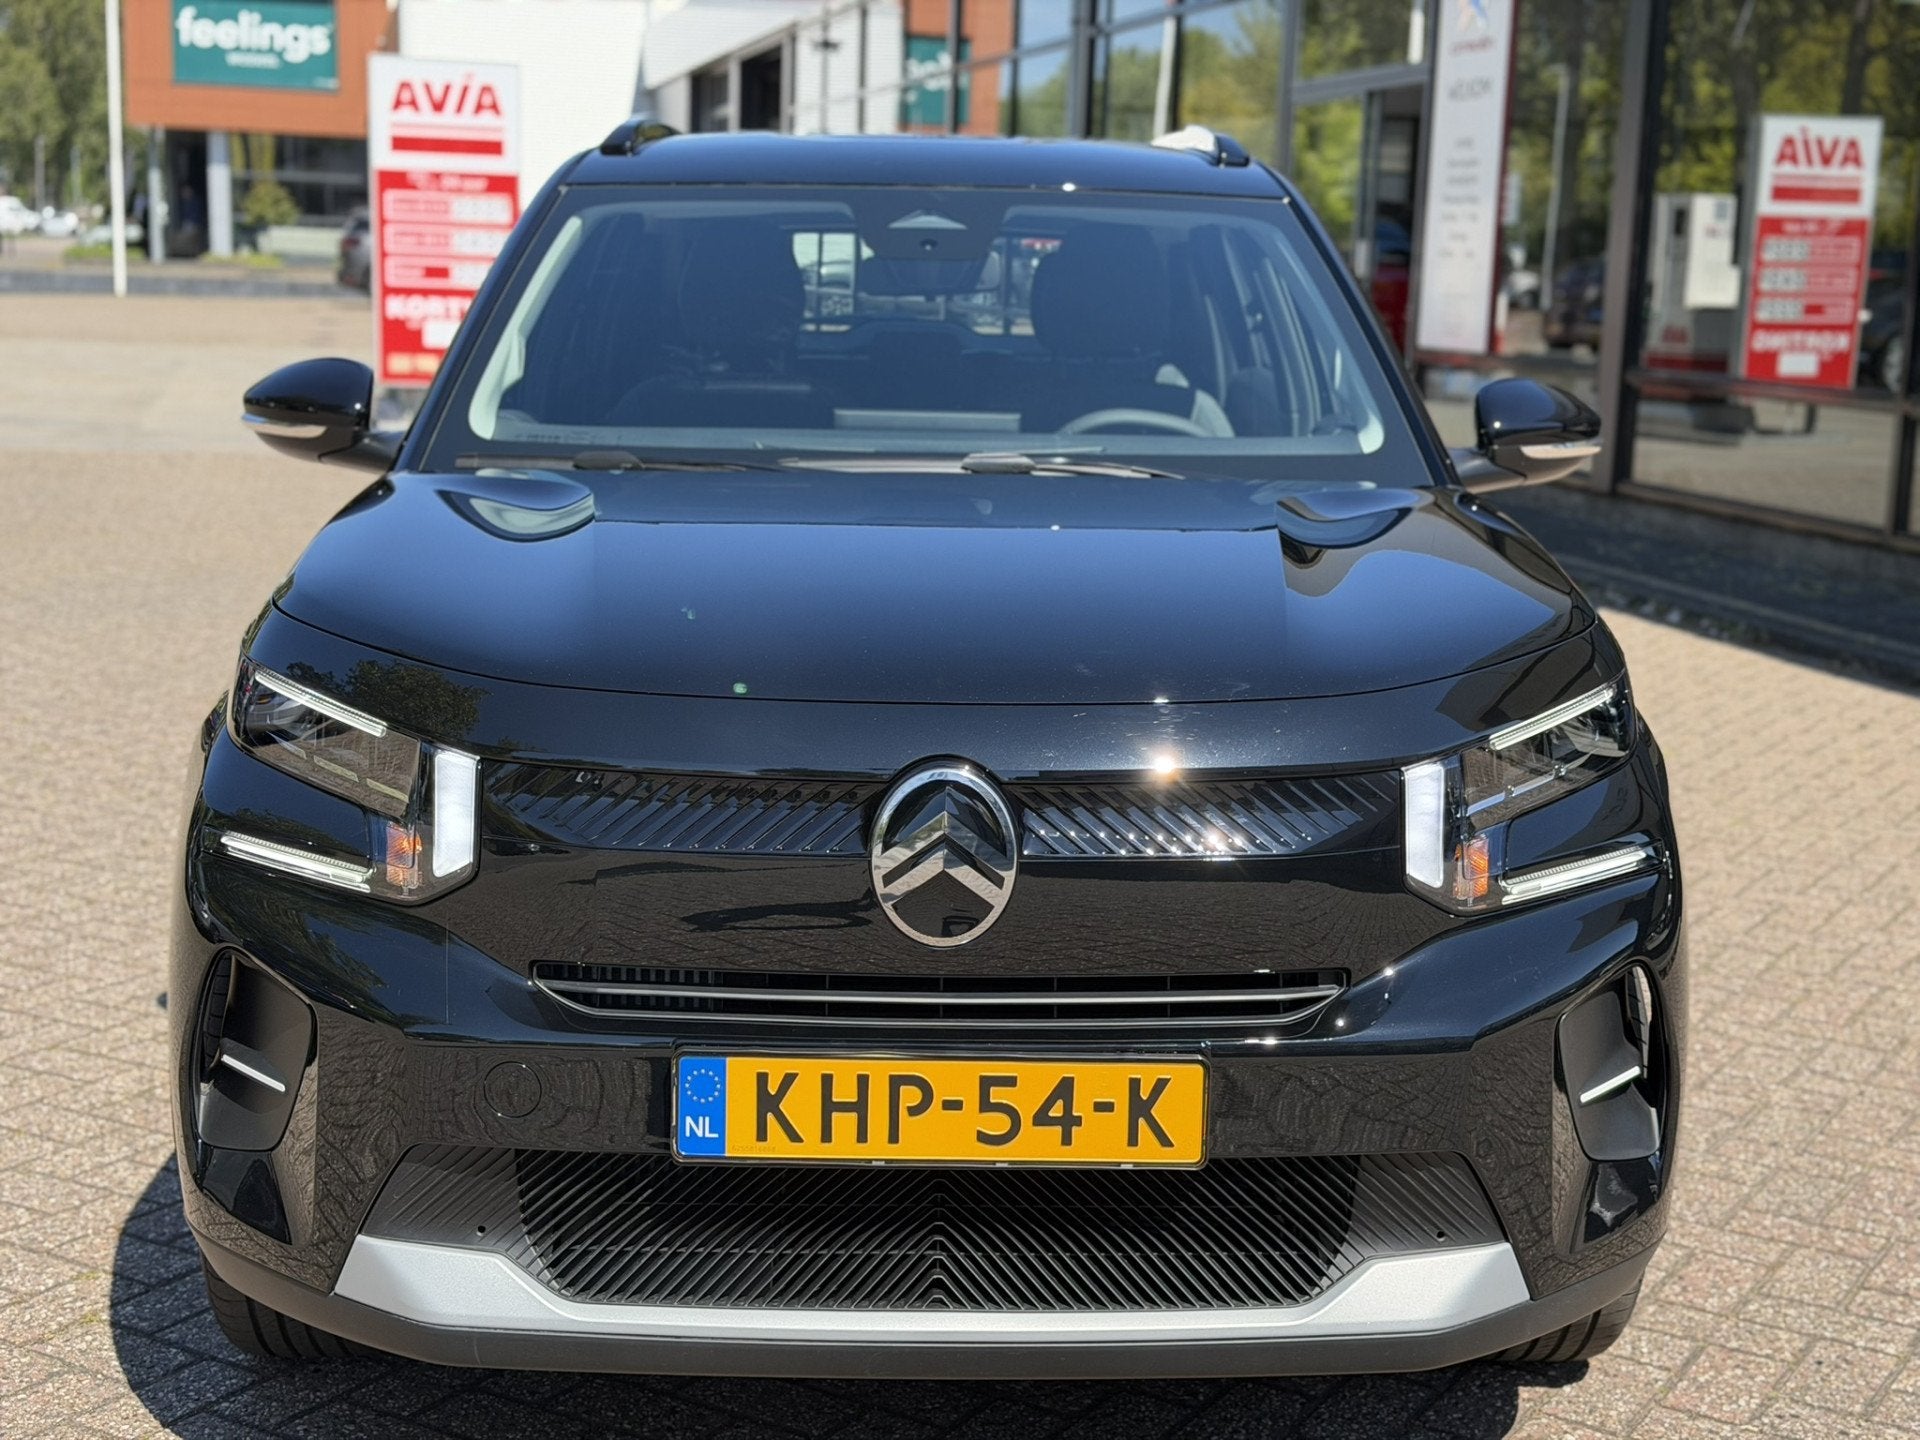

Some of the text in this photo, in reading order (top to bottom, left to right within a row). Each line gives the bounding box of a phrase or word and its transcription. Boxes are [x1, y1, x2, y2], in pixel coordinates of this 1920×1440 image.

[175, 5, 331, 63] feelings
[685, 1115, 719, 1139] NL
[755, 1071, 1175, 1148] KHP-54-K
